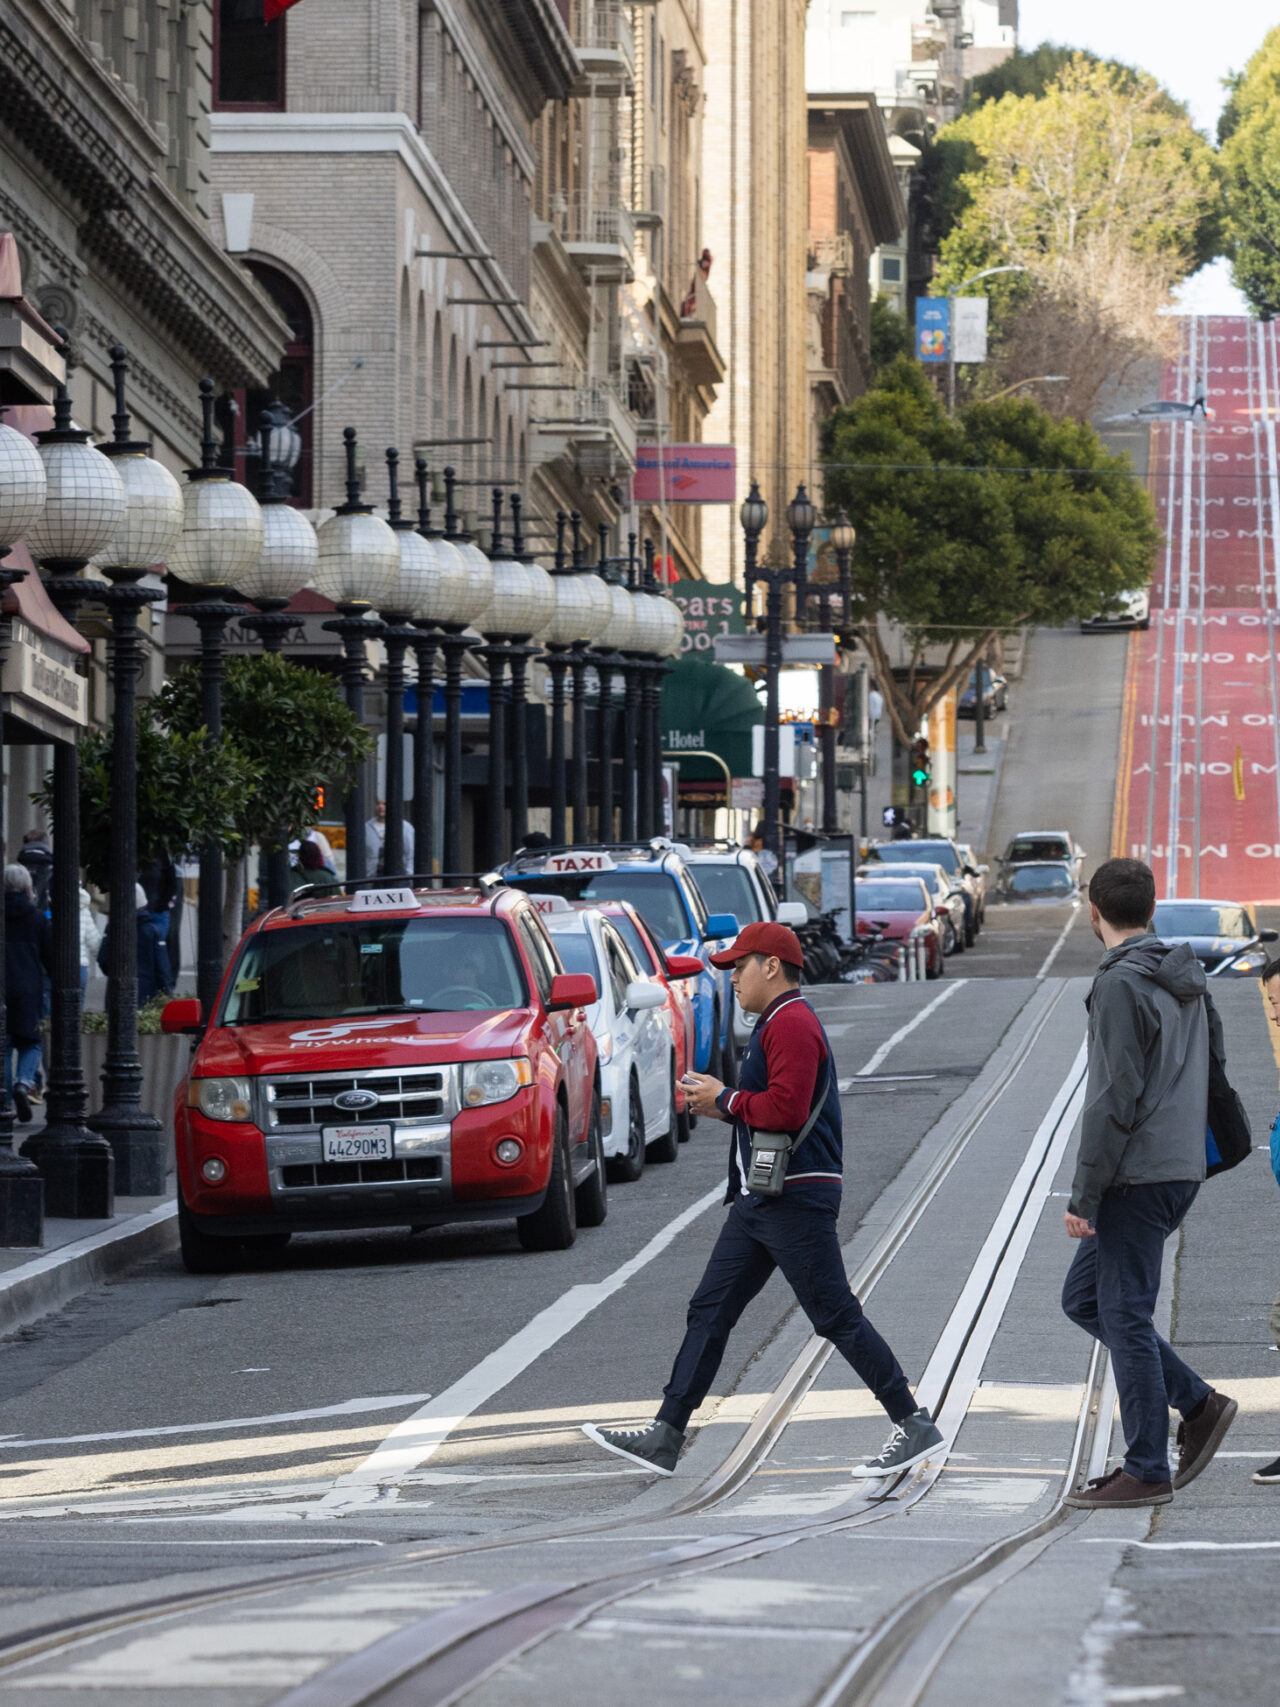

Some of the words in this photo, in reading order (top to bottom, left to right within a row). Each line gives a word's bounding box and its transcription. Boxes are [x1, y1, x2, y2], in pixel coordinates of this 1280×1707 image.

[675, 597, 734, 617] ears
[668, 730, 705, 749] Hotel
[552, 857, 602, 872] TAXI
[361, 892, 404, 905] TAXI
[289, 1036, 414, 1049] Flywheel
[329, 1139, 387, 1156] 44290M3
